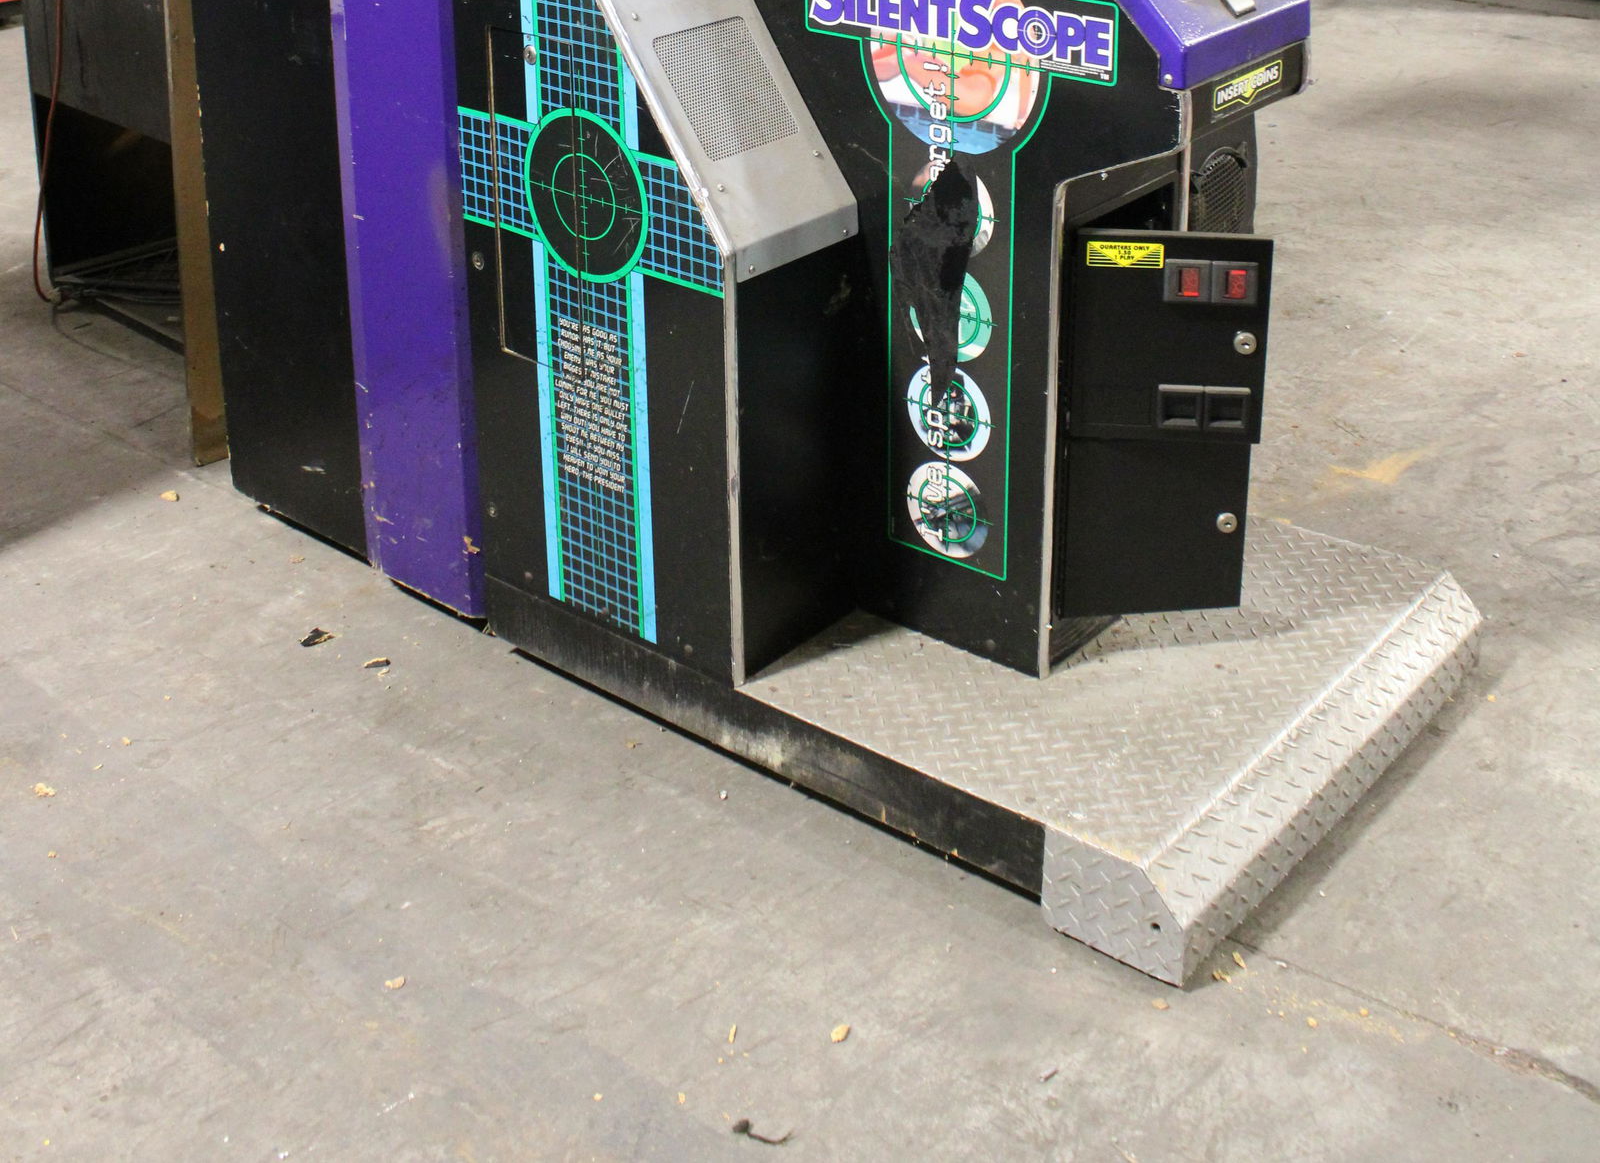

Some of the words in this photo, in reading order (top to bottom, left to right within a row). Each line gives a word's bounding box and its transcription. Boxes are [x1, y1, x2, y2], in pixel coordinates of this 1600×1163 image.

[1217, 79, 1248, 105] INSERT
[1250, 65, 1278, 89] COINS
[583, 325, 590, 334] AS
[592, 328, 607, 339] GOOD
[609, 334, 617, 343] AS
[604, 343, 615, 352] BUT
[597, 351, 604, 360] AS
[606, 354, 622, 366] YOUR
[600, 396, 612, 405] YOU
[613, 400, 629, 411] MUST
[574, 406, 591, 419] THERE
[593, 413, 598, 421] IS
[600, 416, 615, 427] ONLY
[615, 422, 628, 432] ONE
[604, 407, 626, 421] BULLET
[589, 422, 600, 432] YOU
[618, 433, 626, 442] TO
[590, 433, 615, 448] BETWEEN
[594, 445, 606, 455] YOU
[583, 451, 598, 462] SEND
[600, 458, 612, 467] YOU
[613, 462, 621, 471] TO
[582, 471, 593, 481] THE
[594, 475, 625, 493] PRESIDENT
[587, 462, 594, 470] TO
[610, 471, 625, 483] YOUR
[920, 465, 945, 541] I've
